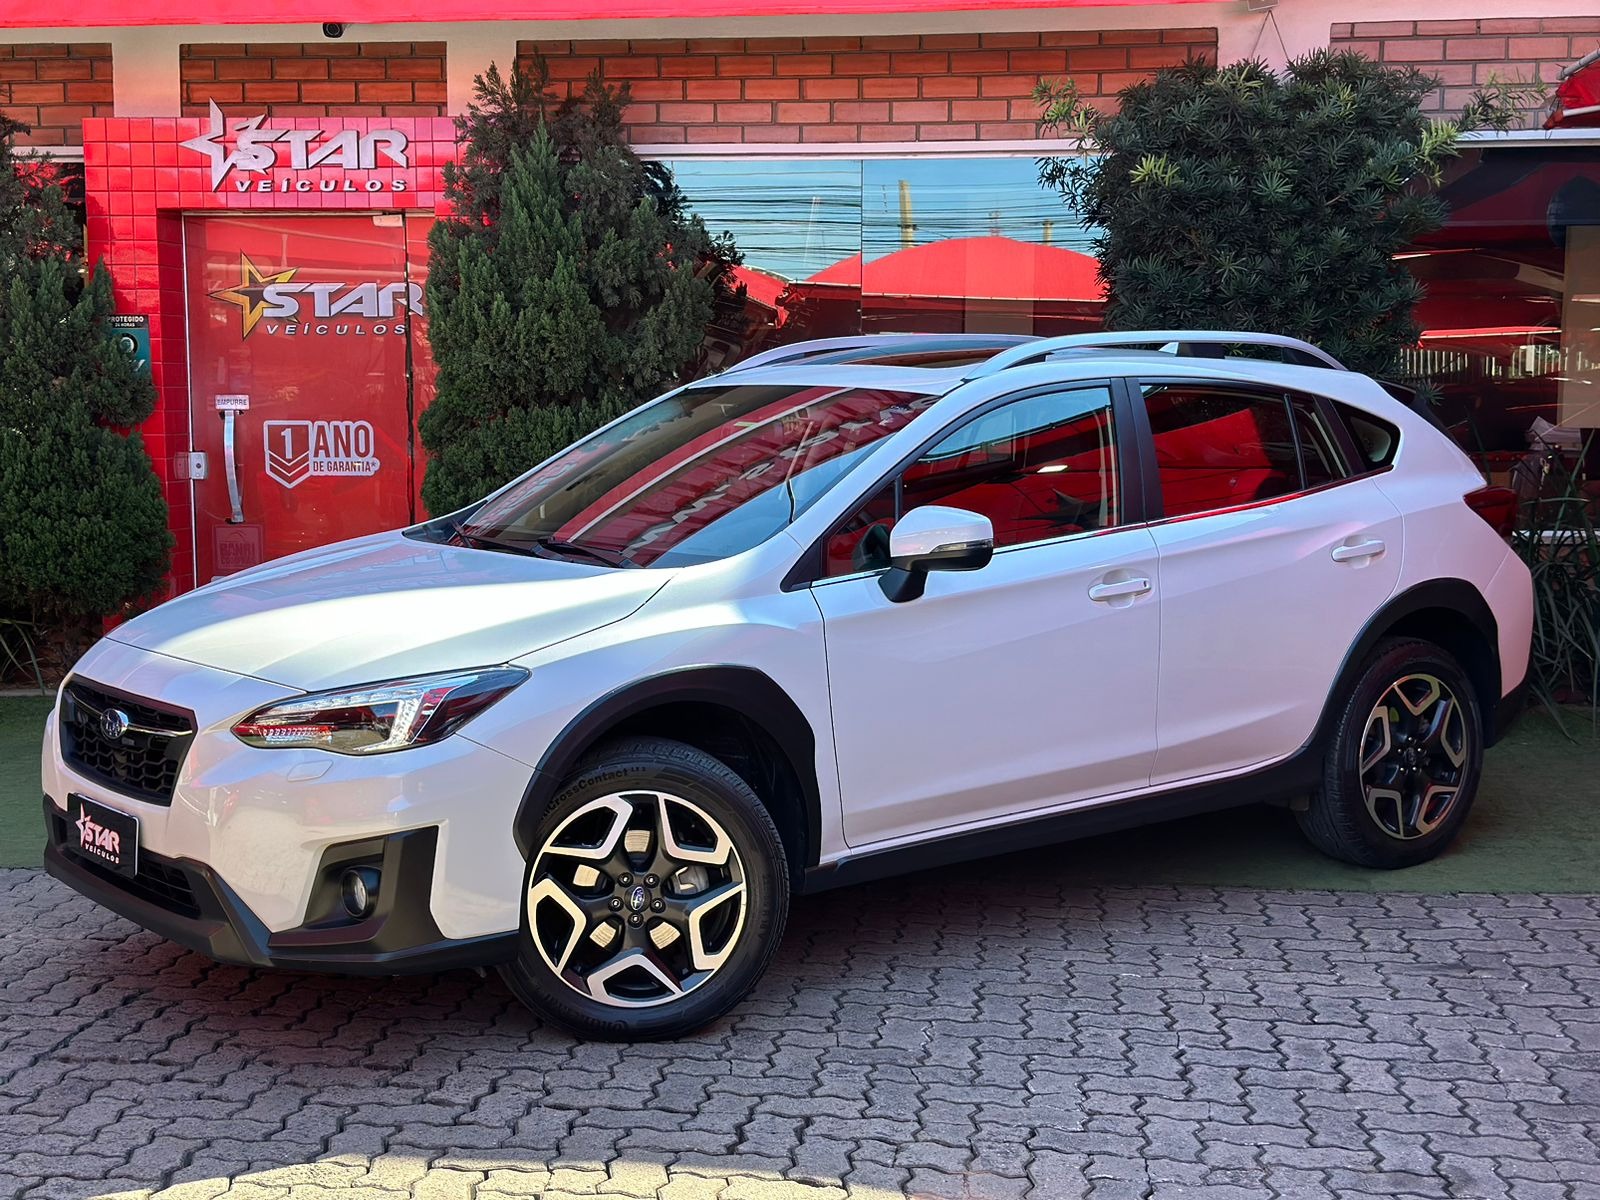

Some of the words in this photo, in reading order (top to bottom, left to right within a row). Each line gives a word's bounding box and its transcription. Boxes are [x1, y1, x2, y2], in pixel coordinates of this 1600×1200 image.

[235, 129, 408, 170] STAR
[235, 178, 408, 193] VEÍCULOS
[263, 281, 424, 318] STAR
[266, 322, 407, 336] VEÍCULOS
[217, 398, 248, 406] EMPURRE
[281, 428, 293, 459] 1
[313, 425, 371, 459] ANO
[313, 461, 325, 472] DE
[84, 820, 120, 855] STAR
